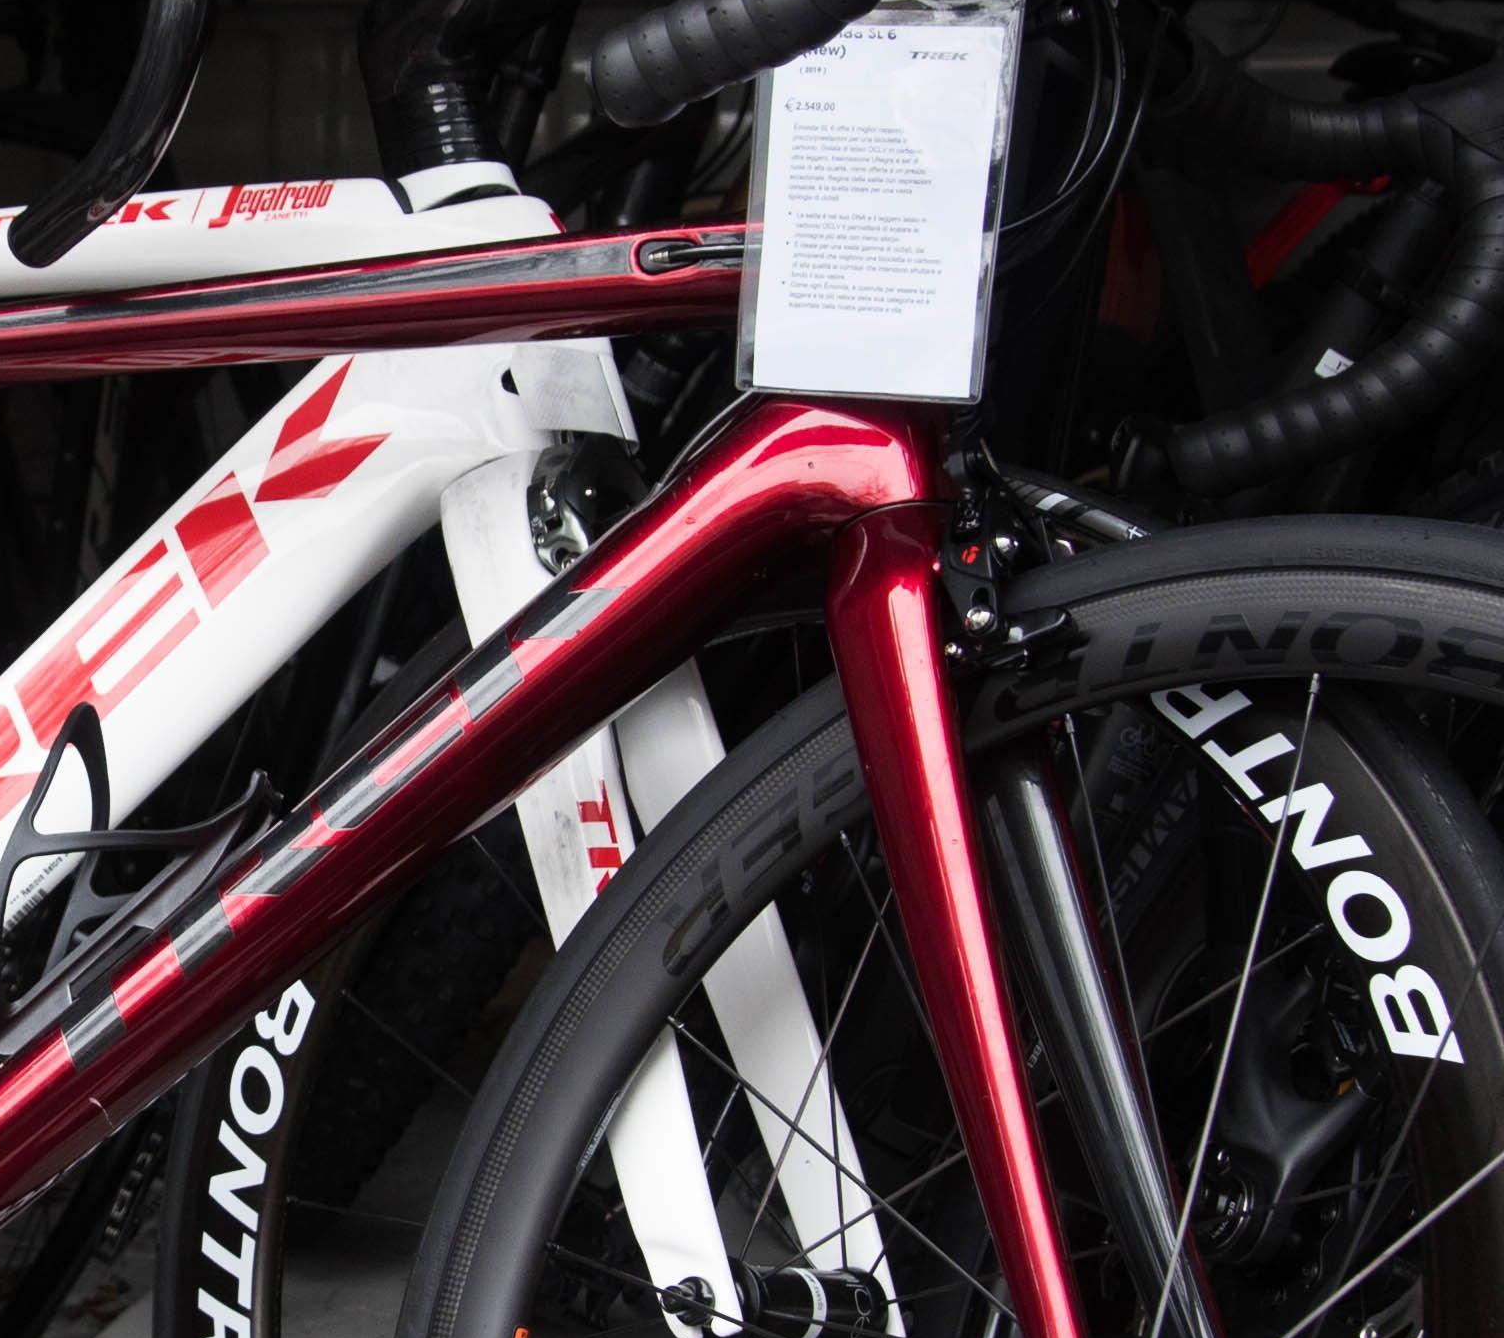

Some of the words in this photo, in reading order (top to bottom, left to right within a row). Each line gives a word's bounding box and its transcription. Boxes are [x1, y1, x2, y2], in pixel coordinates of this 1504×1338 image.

[868, 28, 883, 40] SL
[887, 28, 898, 40] 6
[909, 51, 969, 61] TREK
[208, 179, 335, 230] Segafredo
[262, 210, 310, 223] ZANETTI
[1152, 680, 1467, 1067] BONTR
